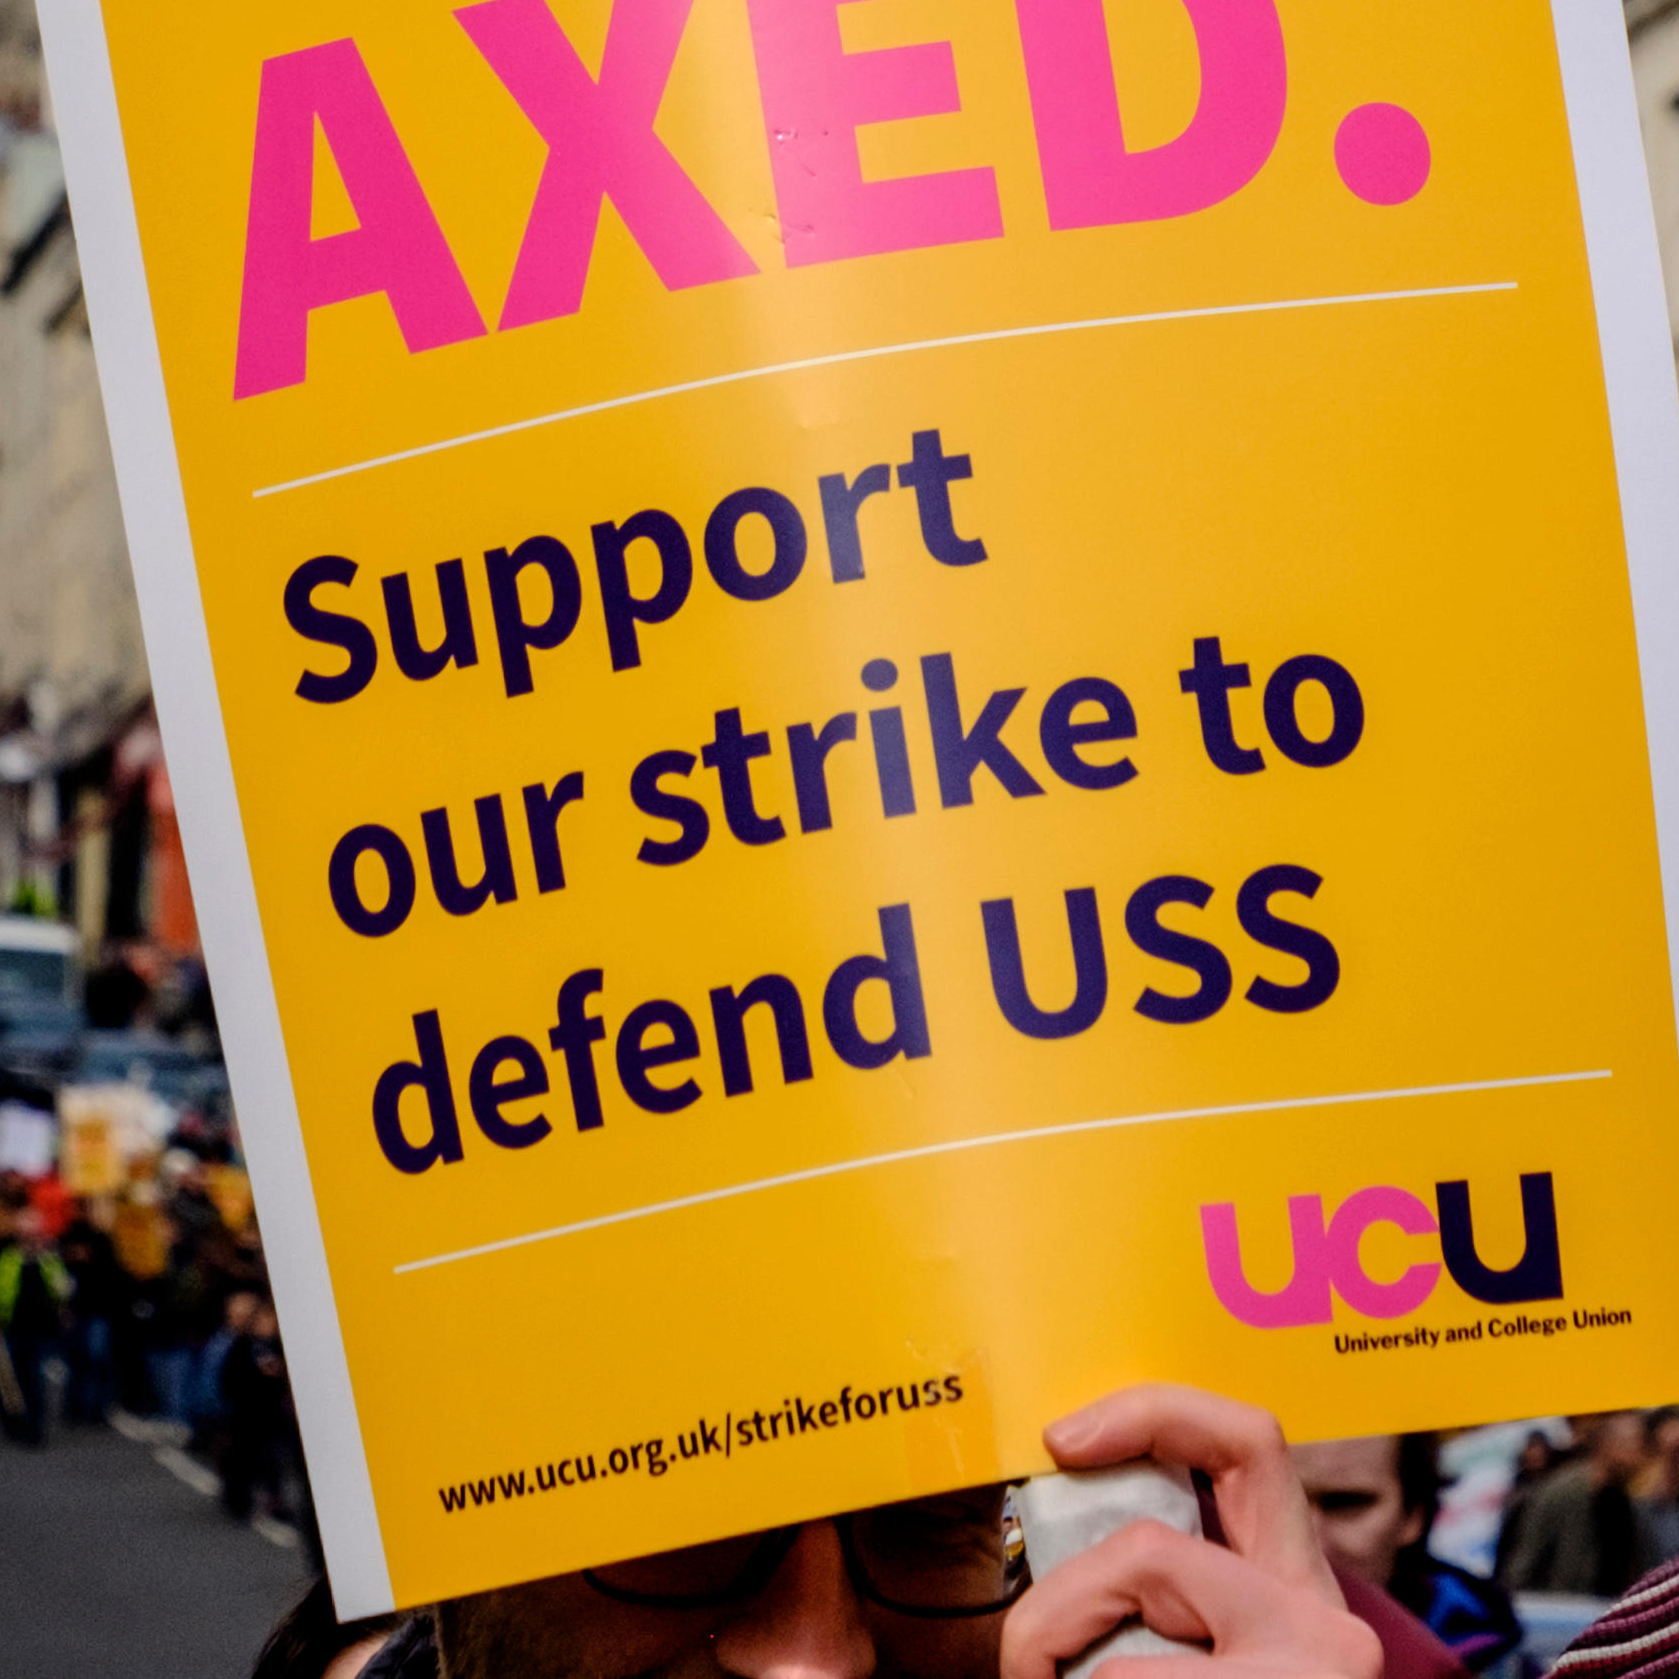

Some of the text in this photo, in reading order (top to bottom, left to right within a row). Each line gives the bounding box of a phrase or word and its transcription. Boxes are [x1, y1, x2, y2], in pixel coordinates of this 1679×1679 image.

[282, 428, 989, 705] Support
[326, 635, 1365, 938] our strike to
[371, 862, 1341, 1176] defend USS
[438, 1374, 964, 1514] www.ucu.org.uk/strikeforuss
[1334, 1306, 1633, 1354] University and College Union
